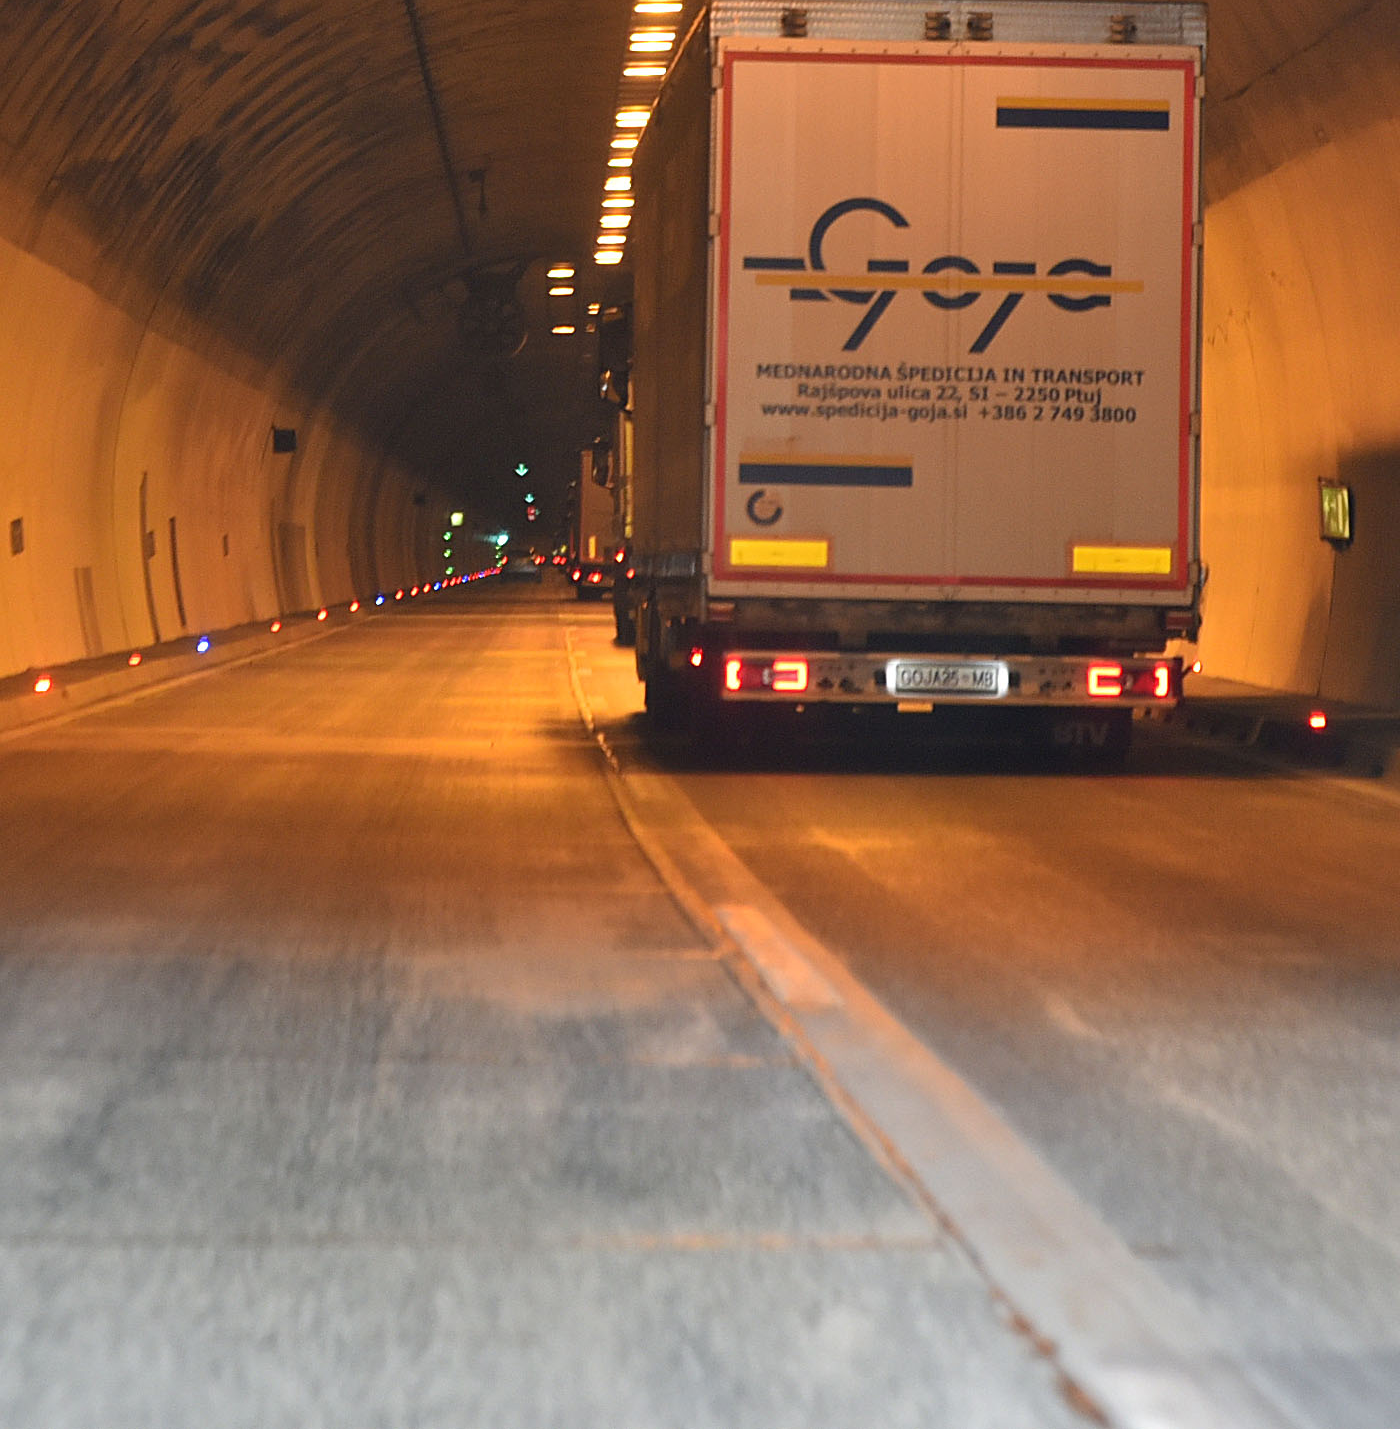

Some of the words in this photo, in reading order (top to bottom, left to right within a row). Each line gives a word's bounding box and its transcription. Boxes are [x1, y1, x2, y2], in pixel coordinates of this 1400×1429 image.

[756, 363, 892, 380] MEDNARODNA
[897, 362, 997, 383] ŠPEDICIJA
[1003, 367, 1026, 383] IN
[1031, 368, 1145, 387] TRANSPORT
[798, 383, 881, 401] Rajšpova
[887, 383, 931, 400] ulica
[937, 385, 963, 403] 22,
[970, 386, 989, 401] SI
[1014, 387, 1060, 404] 2250
[1065, 387, 1103, 407] Ptuj
[762, 402, 968, 422] www.spedicija-goja.si
[979, 404, 1027, 421] +386
[1033, 405, 1044, 421] 2
[1051, 405, 1085, 422] 749
[1091, 405, 1138, 423] 3800
